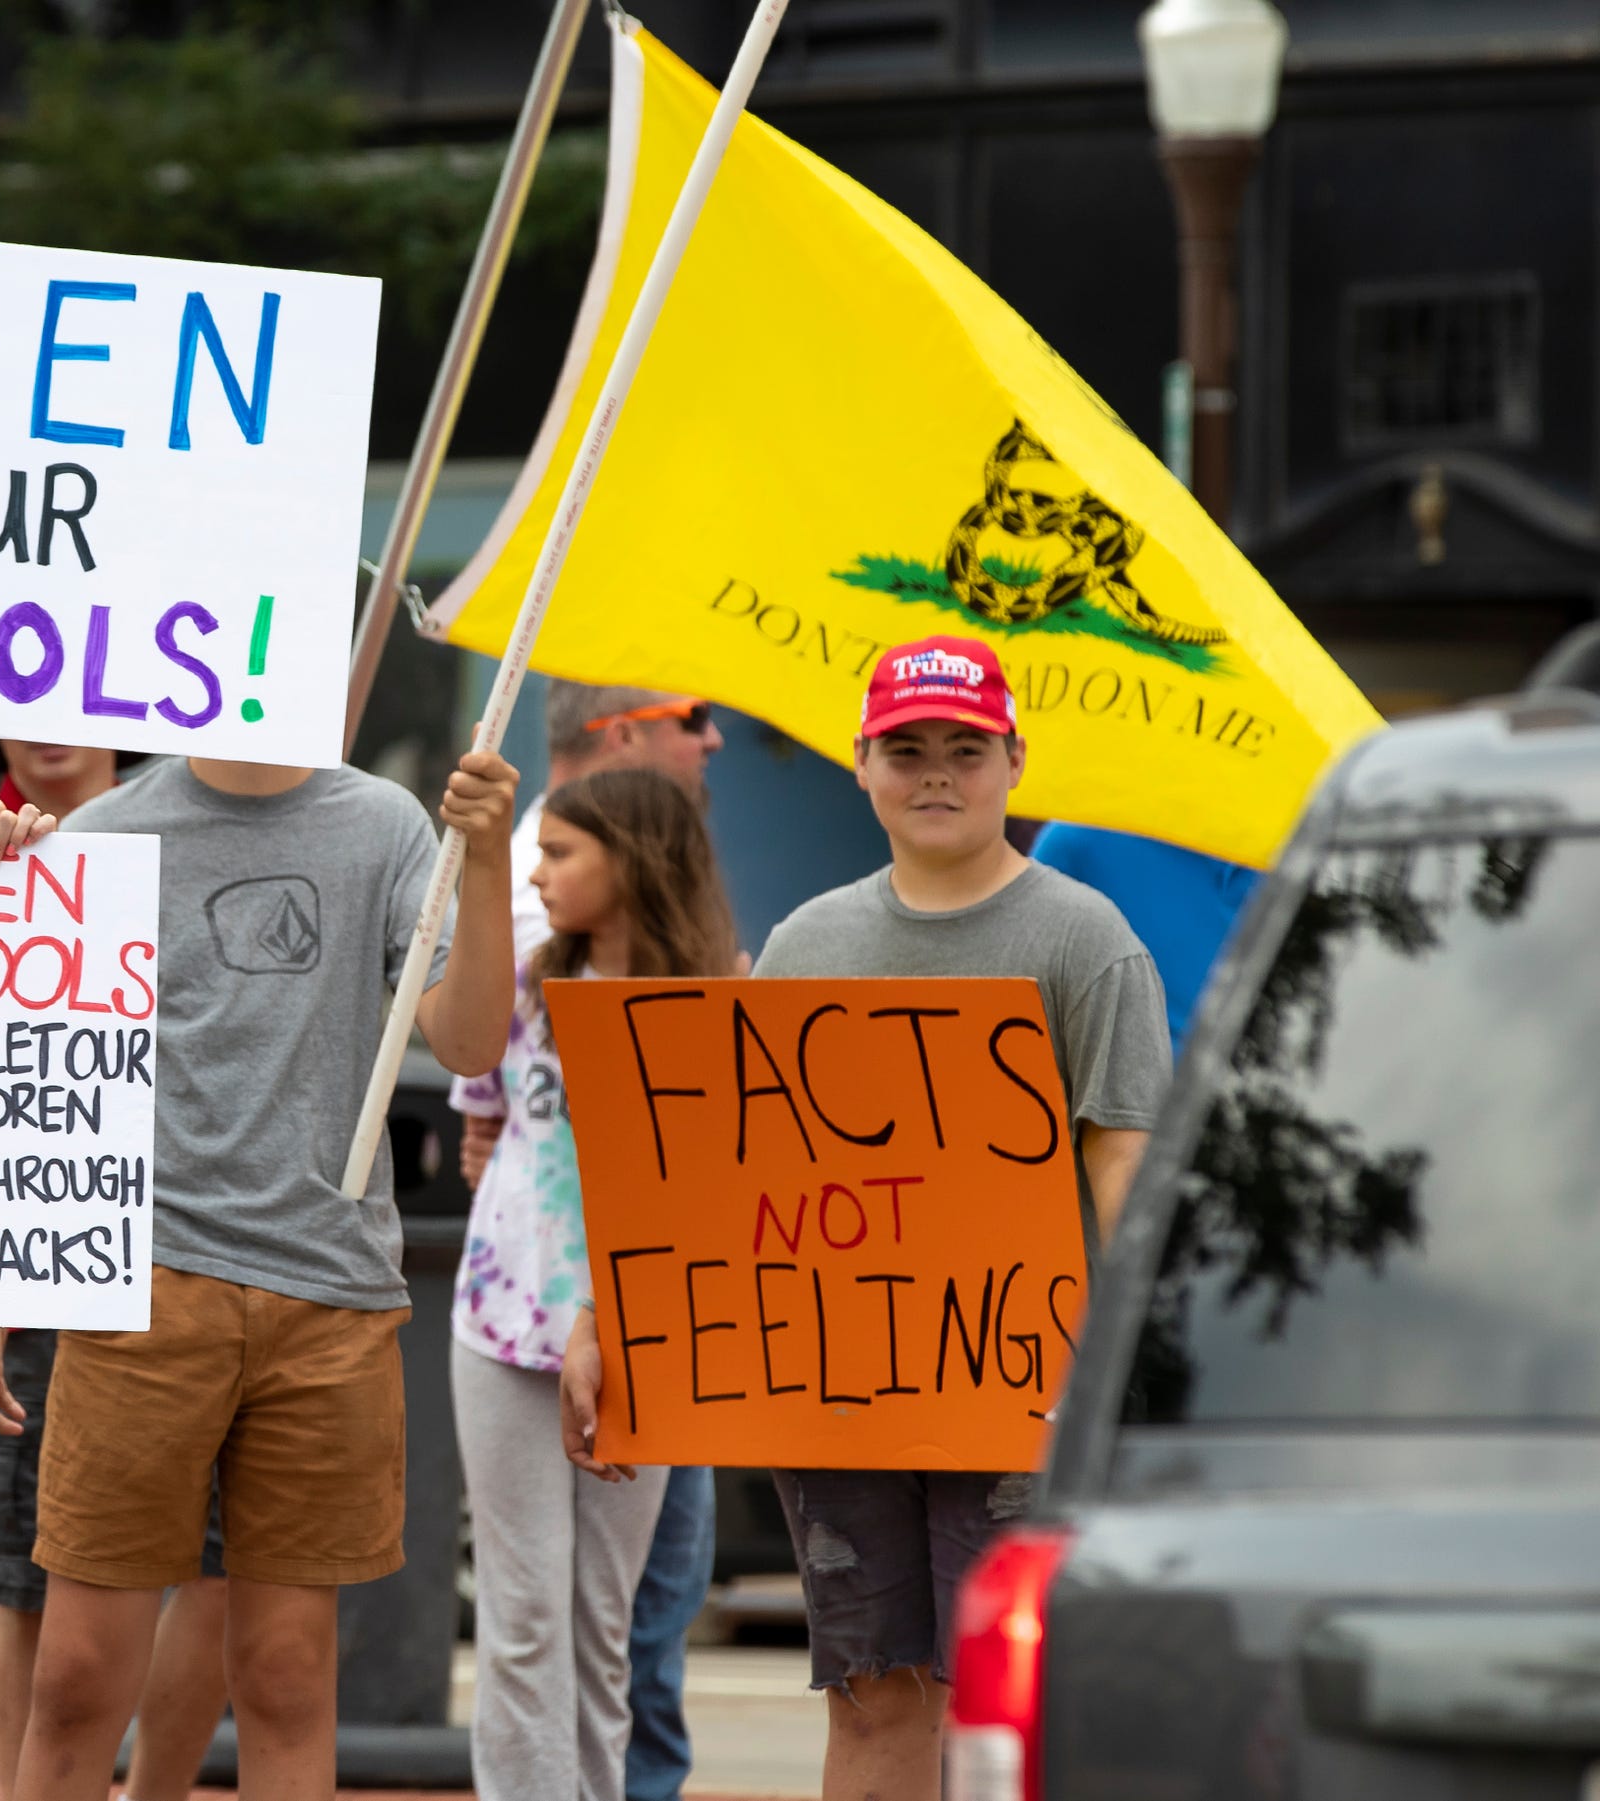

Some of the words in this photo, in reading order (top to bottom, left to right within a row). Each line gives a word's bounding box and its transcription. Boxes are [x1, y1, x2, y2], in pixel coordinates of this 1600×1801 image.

[892, 649, 984, 687] Trump
[1079, 666, 1177, 724] ON
[1176, 696, 1276, 759] ME
[65, 1028, 152, 1087] OUR
[623, 990, 1059, 1181] FACTS
[753, 1176, 925, 1256] NOT
